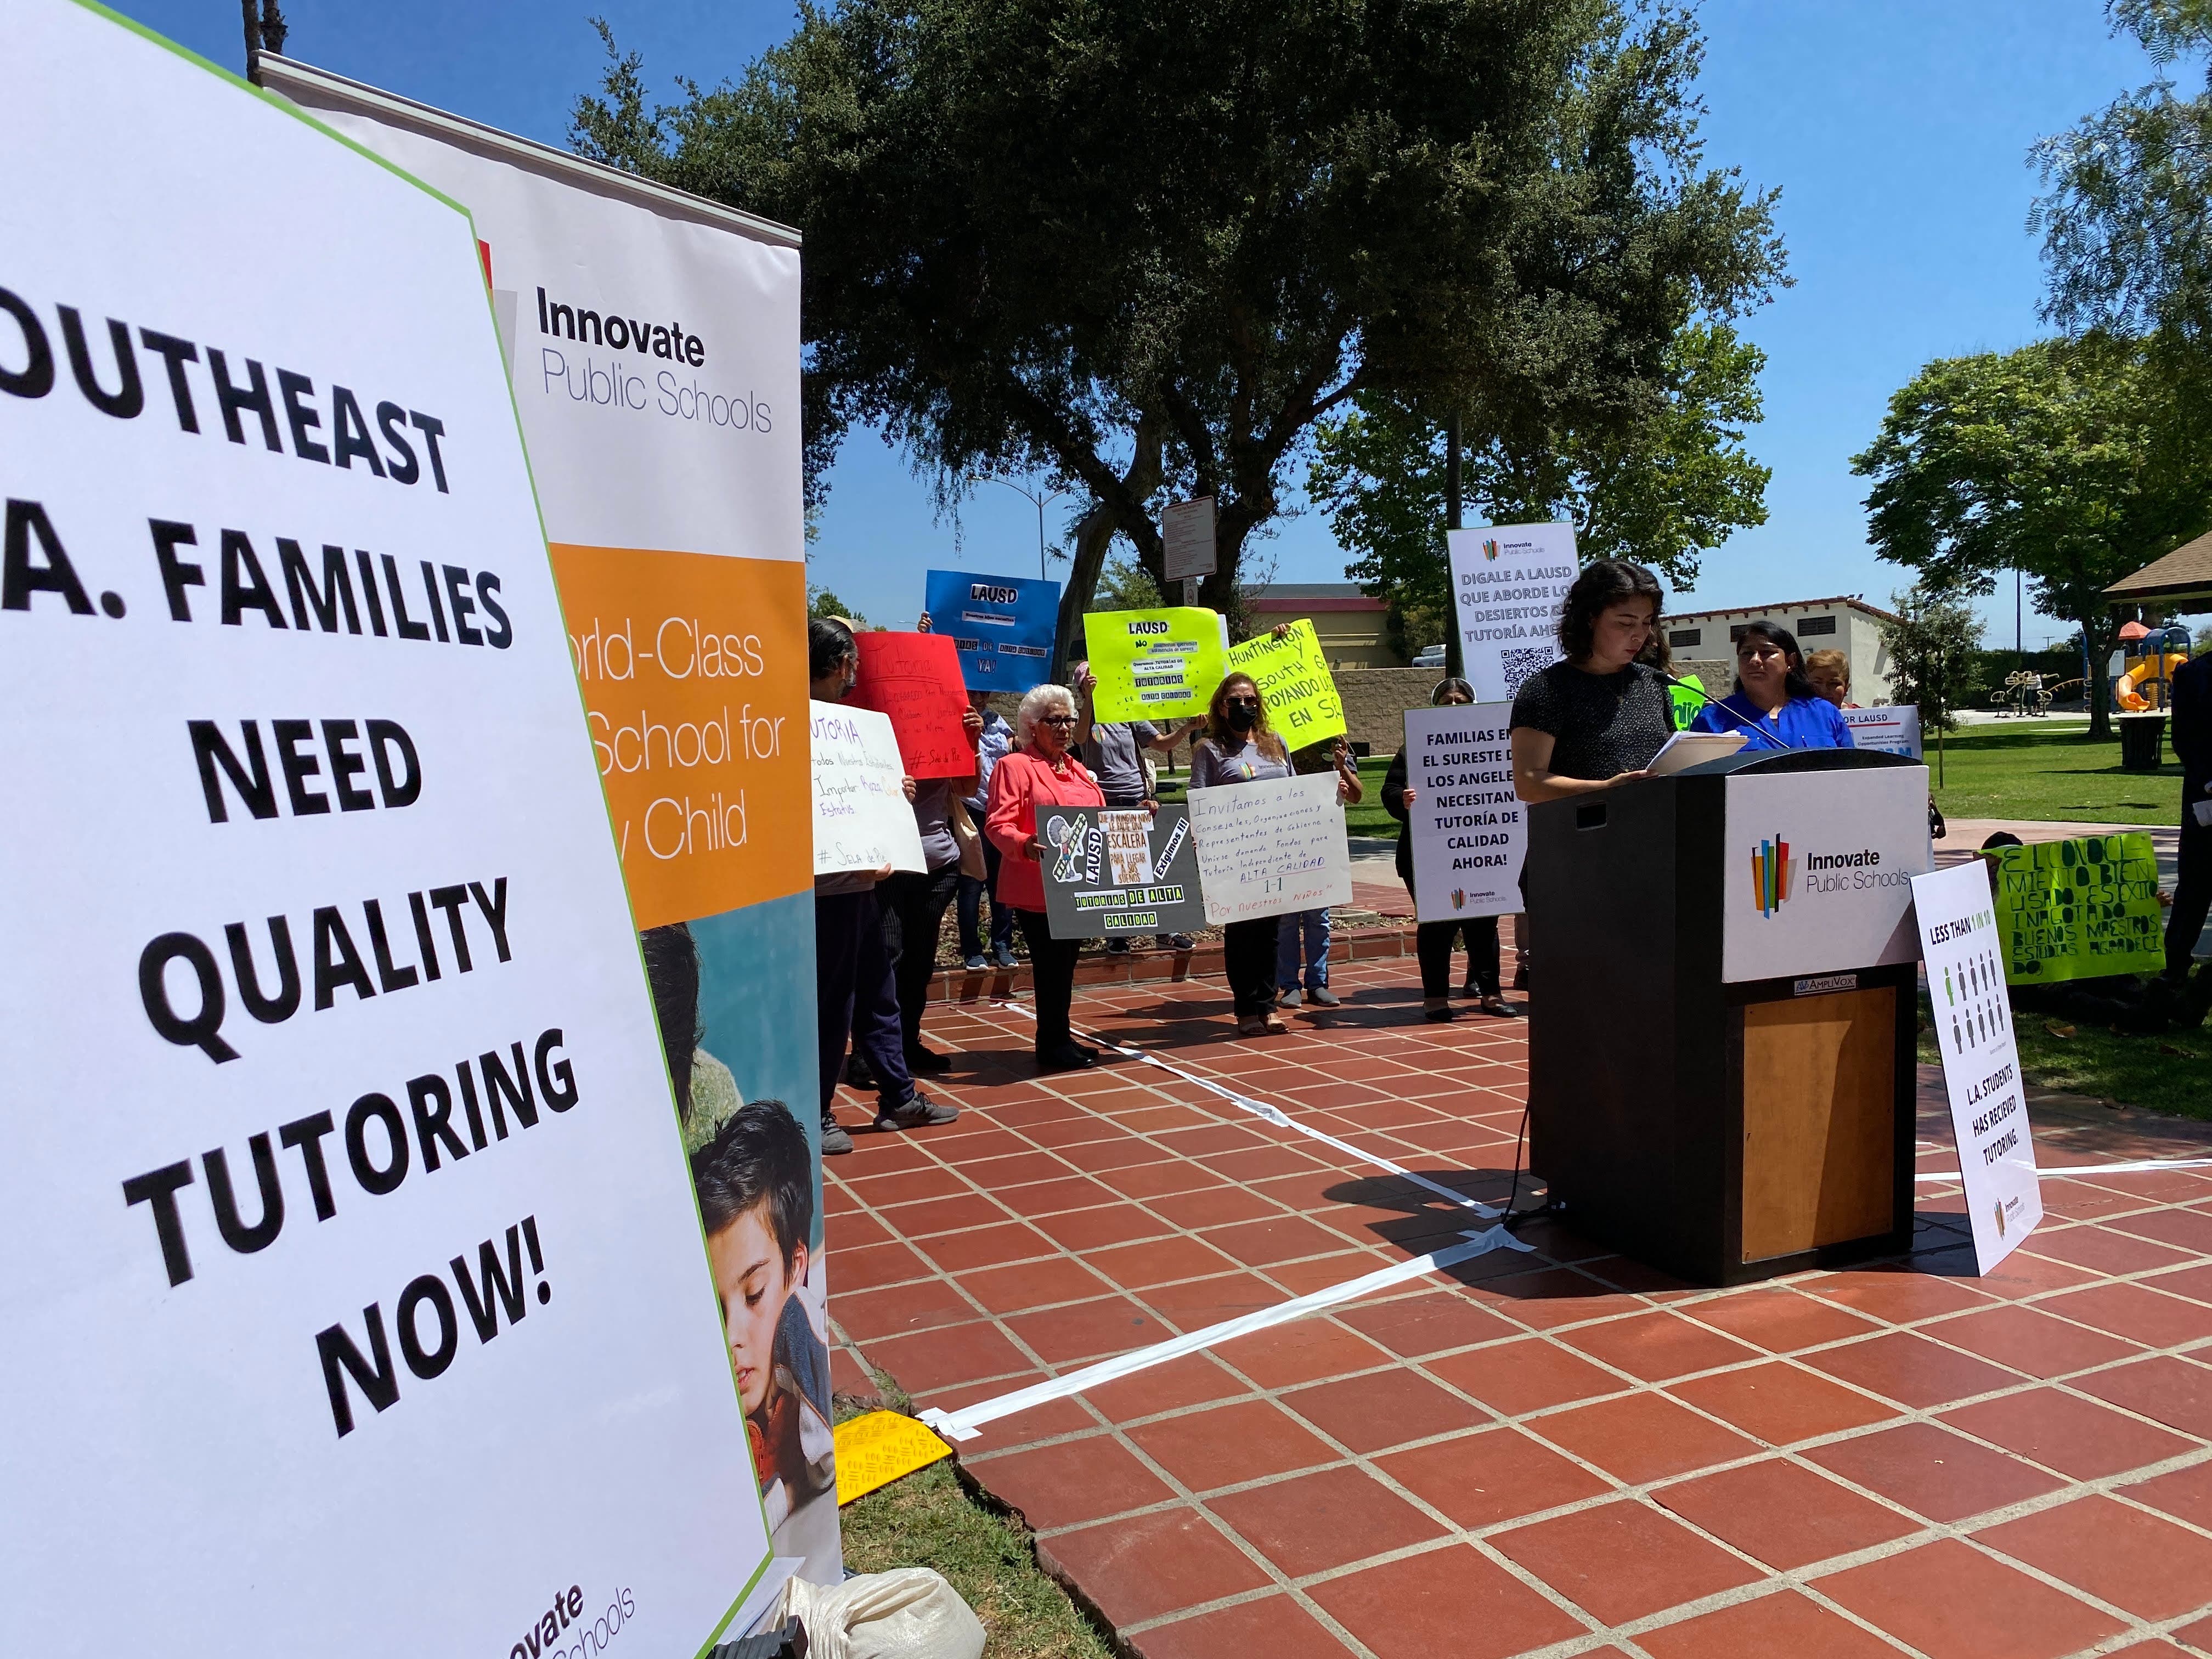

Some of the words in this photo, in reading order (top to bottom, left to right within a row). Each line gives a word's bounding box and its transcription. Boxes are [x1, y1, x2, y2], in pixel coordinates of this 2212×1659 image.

[537, 286, 704, 367] Innovate
[542, 348, 646, 410] Public
[657, 371, 772, 433] Schools
[148, 517, 512, 650] FAMILIES
[1462, 570, 1511, 585] DIGALE
[1515, 569, 1525, 581] A
[1528, 566, 1572, 579] LAUSD
[970, 585, 1017, 603] LAUSD
[1460, 591, 1489, 606] QUE
[1493, 586, 1549, 602] ABORDE
[1475, 605, 1548, 622] DESIERTOS
[1128, 622, 1167, 634] LAUSD
[1465, 624, 1527, 642] TUTORÍA
[983, 642, 994, 651] DE
[978, 659, 996, 673] YA!
[1256, 661, 1308, 690] SOUTH
[1135, 675, 1183, 687] TUTORIAS
[1289, 707, 1313, 728] EN
[1859, 714, 1888, 723] LAUSD
[588, 706, 731, 776] School
[740, 704, 785, 759] for
[1426, 730, 1494, 746] FAMILIAS
[1423, 755, 1438, 767] EL
[1443, 750, 1502, 765] SURESTE
[187, 719, 421, 823] NEED
[1427, 775, 1454, 788] LOS
[1193, 794, 1266, 816] Invitamos
[1289, 788, 1304, 798] los
[1436, 791, 1514, 808] NECESITAN
[645, 789, 747, 860] Child
[1132, 822, 1143, 830] UNA
[1435, 811, 1498, 830] TUTORÍA
[1502, 811, 1519, 823] DE
[1107, 833, 1147, 848] ESCALERA
[1199, 830, 1267, 848] Representantes
[1447, 833, 1509, 849] CALIDAD
[817, 849, 832, 864] #
[1086, 831, 1101, 884] LAUSD
[1110, 852, 1124, 864] PARA
[1126, 853, 1146, 864] LLEGAR
[1155, 833, 1181, 876] Exigimos
[1202, 854, 1228, 864] Unirse
[1277, 838, 1301, 848] Fondos
[1311, 835, 1329, 845] para
[1127, 864, 1138, 873] SUS
[1240, 868, 1267, 882] ALTA
[1277, 856, 1325, 873] CALIDAD
[1452, 854, 1507, 870] AHORA!
[1808, 849, 1880, 871] Innovate
[1265, 877, 1282, 893] 1-1
[1807, 873, 1849, 893] Public
[1853, 868, 1909, 889] Schools
[2006, 866, 2090, 893] MIENTO
[2098, 859, 2150, 885] BIEN
[1076, 894, 1125, 907] TUTORIAS
[1129, 890, 1144, 904] DE
[1149, 886, 1182, 902] ALTA
[1239, 897, 1282, 912] nuestros
[1106, 912, 1156, 927] CALIDAD
[1930, 923, 1950, 945] LESS
[1950, 917, 1972, 939] THAN
[1972, 915, 1976, 931] 1
[1977, 912, 1983, 929] IN
[1984, 909, 1991, 926] 10
[2012, 924, 2078, 947] BUENOS
[2086, 913, 2159, 939] MAESTROS
[139, 876, 512, 1064] QUALITY
[1967, 1084, 1983, 1105] L.A.
[1983, 1063, 2013, 1095] STUDENTS
[1972, 1114, 1989, 1137] HAS
[1989, 1095, 2016, 1126] RECIEVED
[1983, 1128, 2018, 1166] TUTORING.
[122, 1028, 579, 1288] TUTORING
[314, 1214, 551, 1439] NOW!
